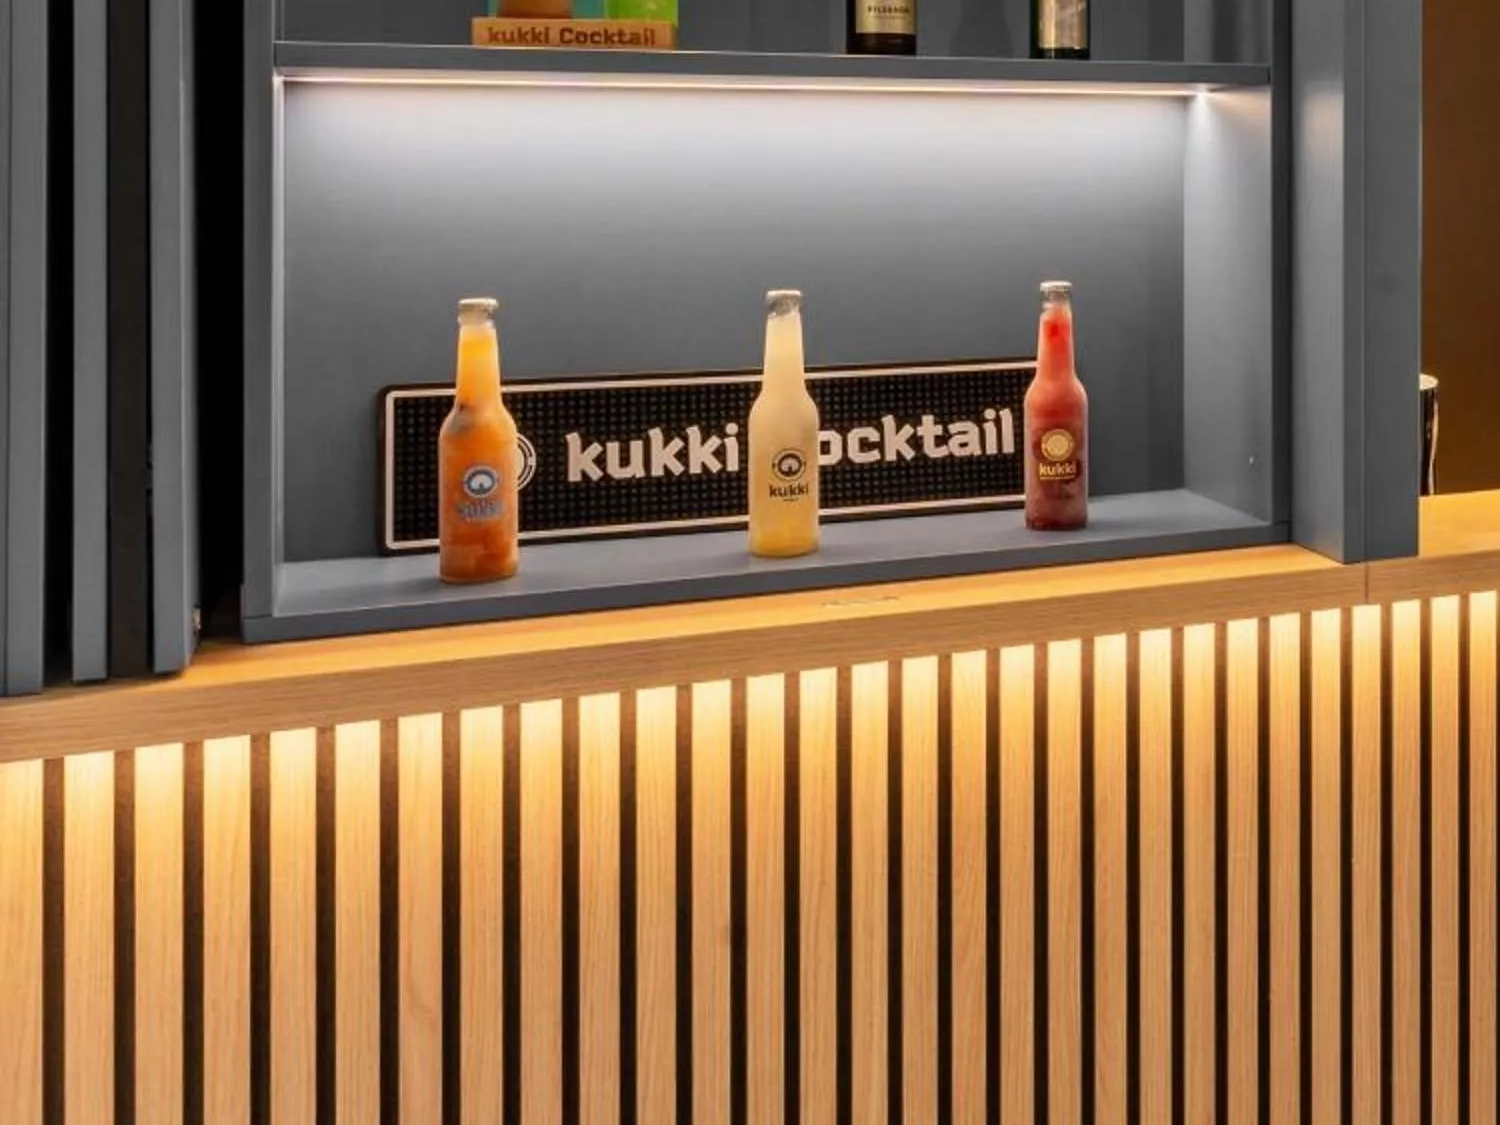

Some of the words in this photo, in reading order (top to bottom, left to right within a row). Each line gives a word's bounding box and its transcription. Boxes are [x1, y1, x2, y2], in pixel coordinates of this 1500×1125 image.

[487, 26, 550, 44] kukki
[558, 27, 656, 47] Cocktail
[565, 422, 740, 483] kukki
[817, 408, 1015, 466] ocktail
